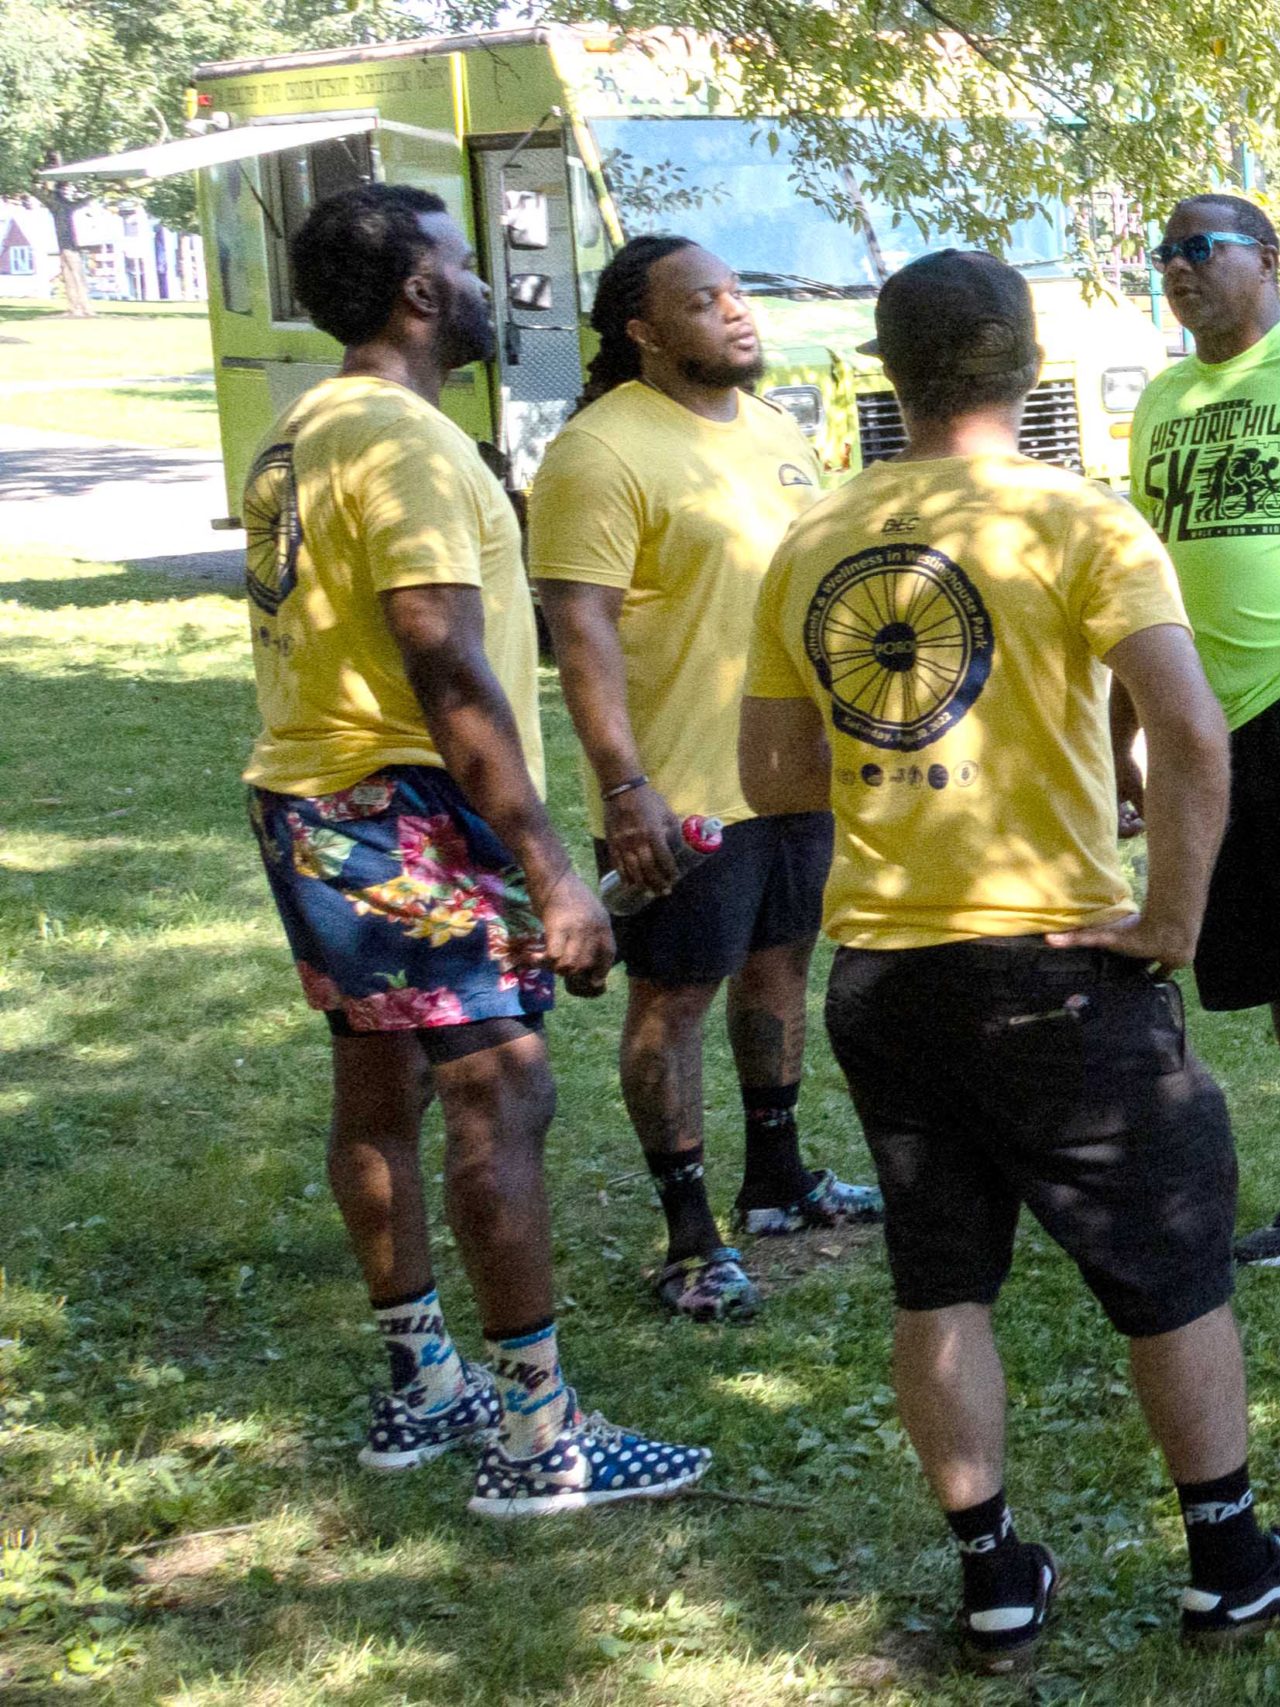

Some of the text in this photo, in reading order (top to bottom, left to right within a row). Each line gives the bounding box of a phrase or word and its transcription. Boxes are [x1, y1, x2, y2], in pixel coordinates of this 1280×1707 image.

[1150, 410, 1241, 456] HISTORIC
[821, 554, 884, 595] Wellness
[886, 549, 902, 561] in
[973, 616, 989, 650] Park
